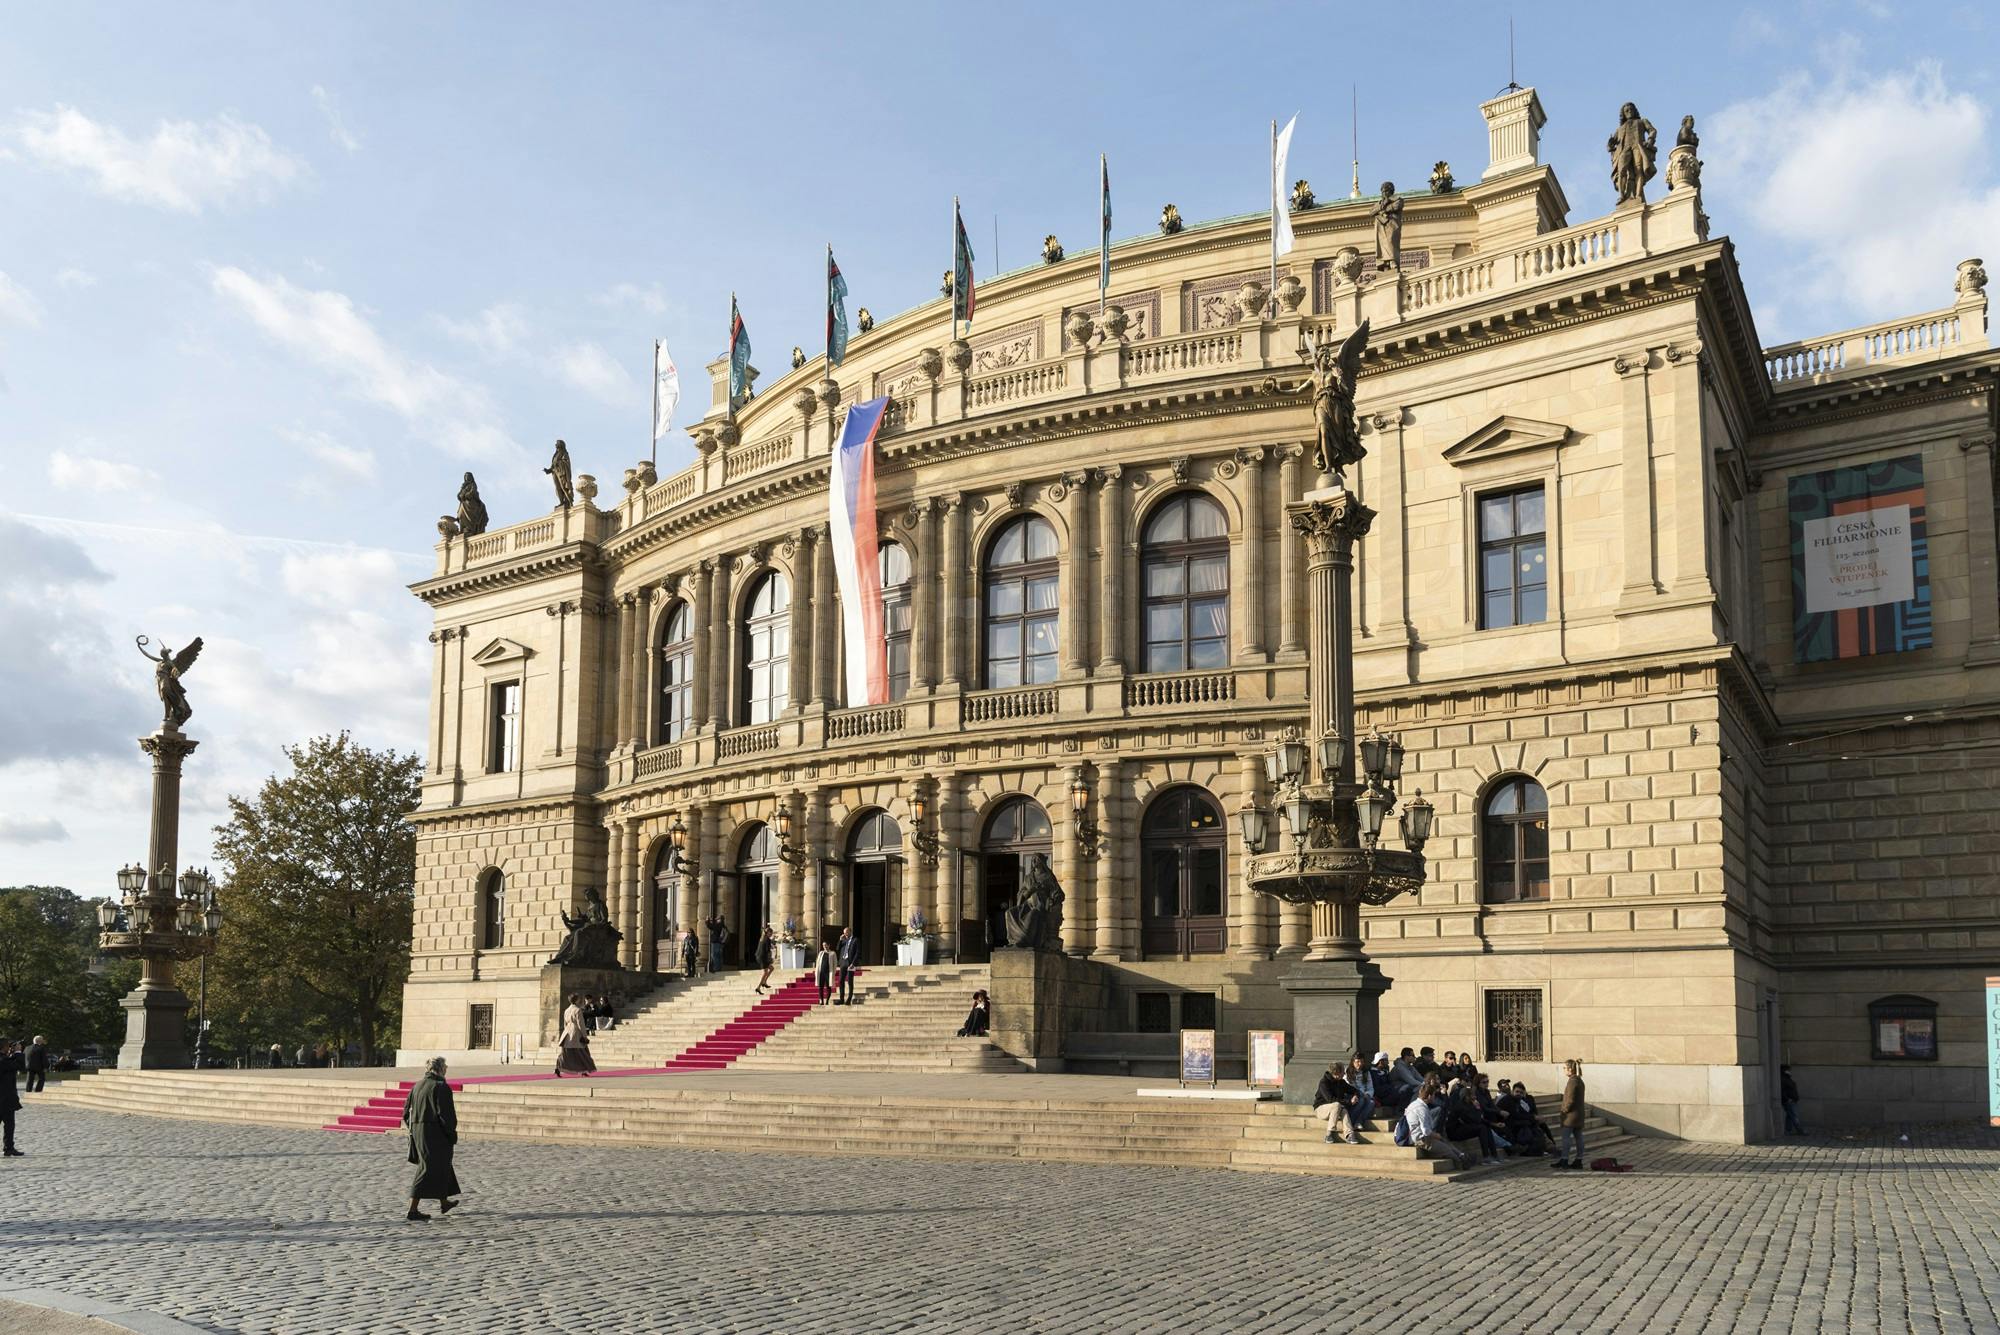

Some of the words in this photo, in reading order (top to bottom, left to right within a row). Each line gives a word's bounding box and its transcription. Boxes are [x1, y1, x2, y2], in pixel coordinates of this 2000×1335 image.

[1837, 520, 1876, 534] ČESKÁ
[1814, 526, 1902, 547] FILHARMONIE
[1839, 561, 1878, 574] PRODEJ
[1828, 568, 1888, 584] VSTUPENEK
